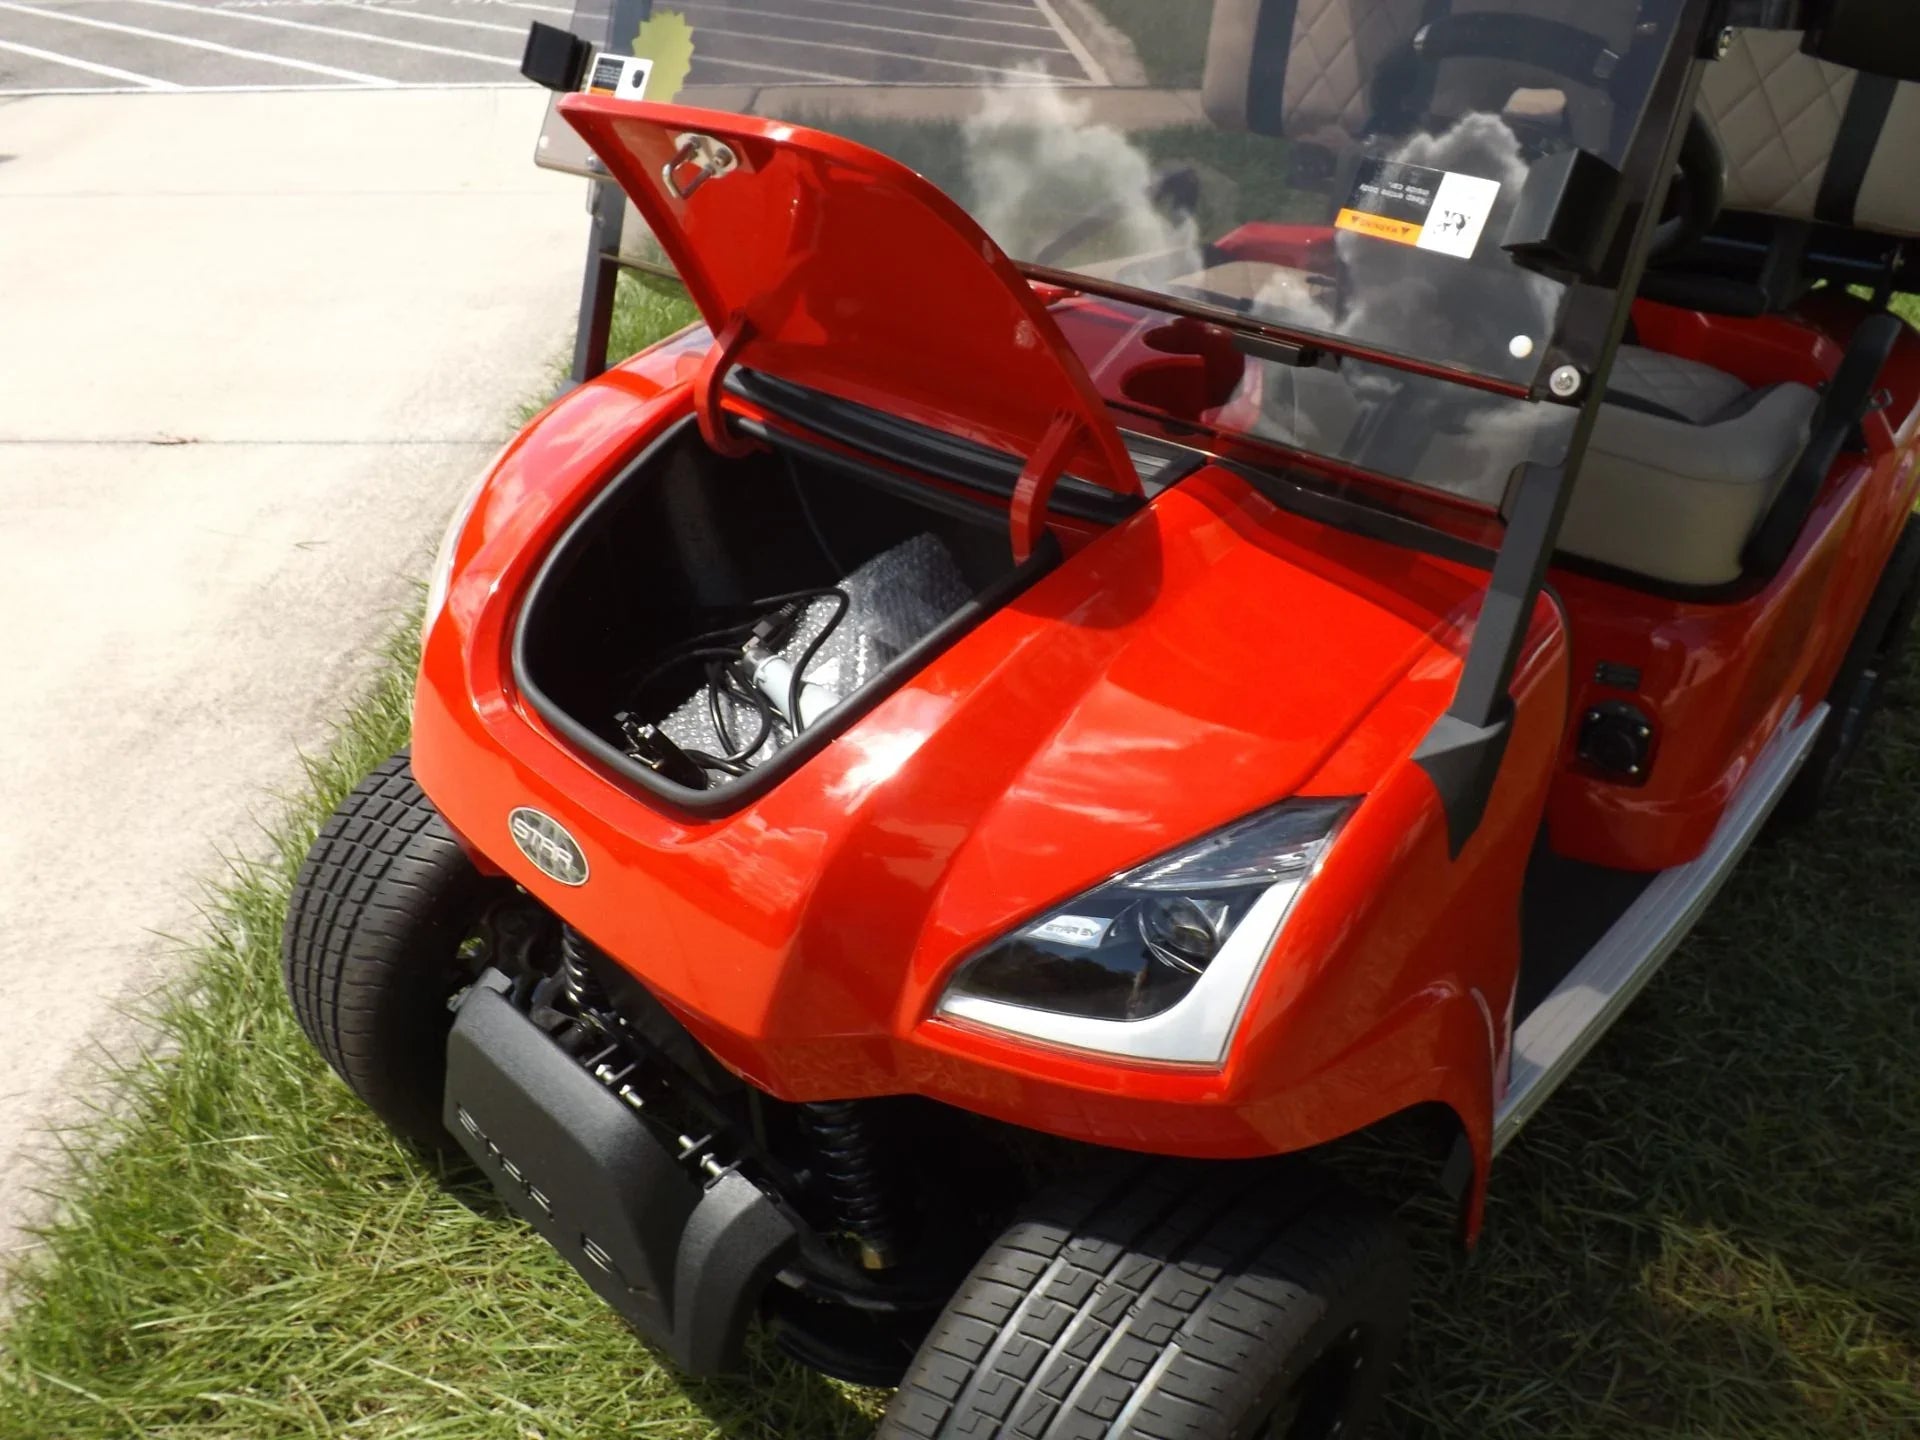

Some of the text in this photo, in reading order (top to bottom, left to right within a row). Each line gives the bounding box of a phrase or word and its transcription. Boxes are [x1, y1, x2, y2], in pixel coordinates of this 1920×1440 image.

[513, 817, 574, 870] STAR
[1046, 924, 1080, 935] STAR
[456, 1102, 555, 1222] STAR
